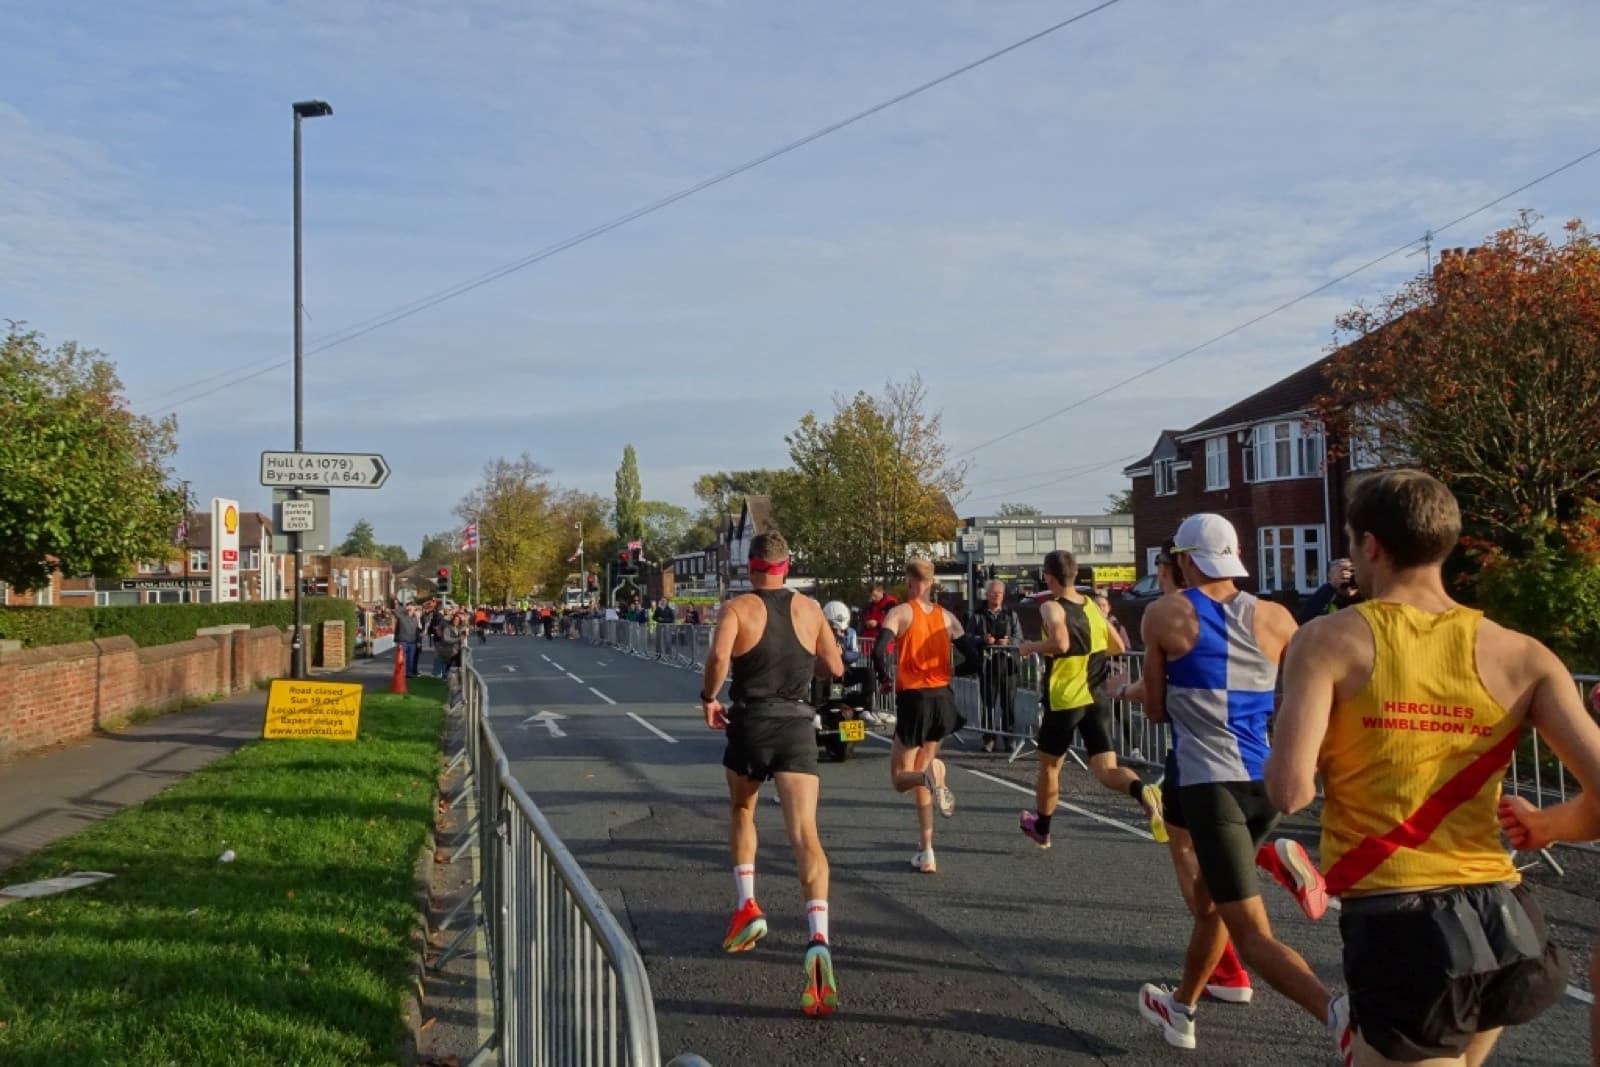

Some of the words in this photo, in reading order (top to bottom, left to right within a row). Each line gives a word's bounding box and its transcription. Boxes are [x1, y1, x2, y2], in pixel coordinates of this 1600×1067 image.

[266, 457, 294, 468] Hull
[289, 686, 312, 695] Road
[314, 687, 344, 696] closed
[290, 696, 309, 704] Sun
[271, 706, 296, 714] Local
[326, 708, 355, 716] closed
[1383, 701, 1474, 719] HERCULES
[280, 716, 312, 725] Expect
[314, 717, 343, 727] delays
[1362, 717, 1465, 734] WIMBLEDON
[1469, 724, 1492, 737] AC
